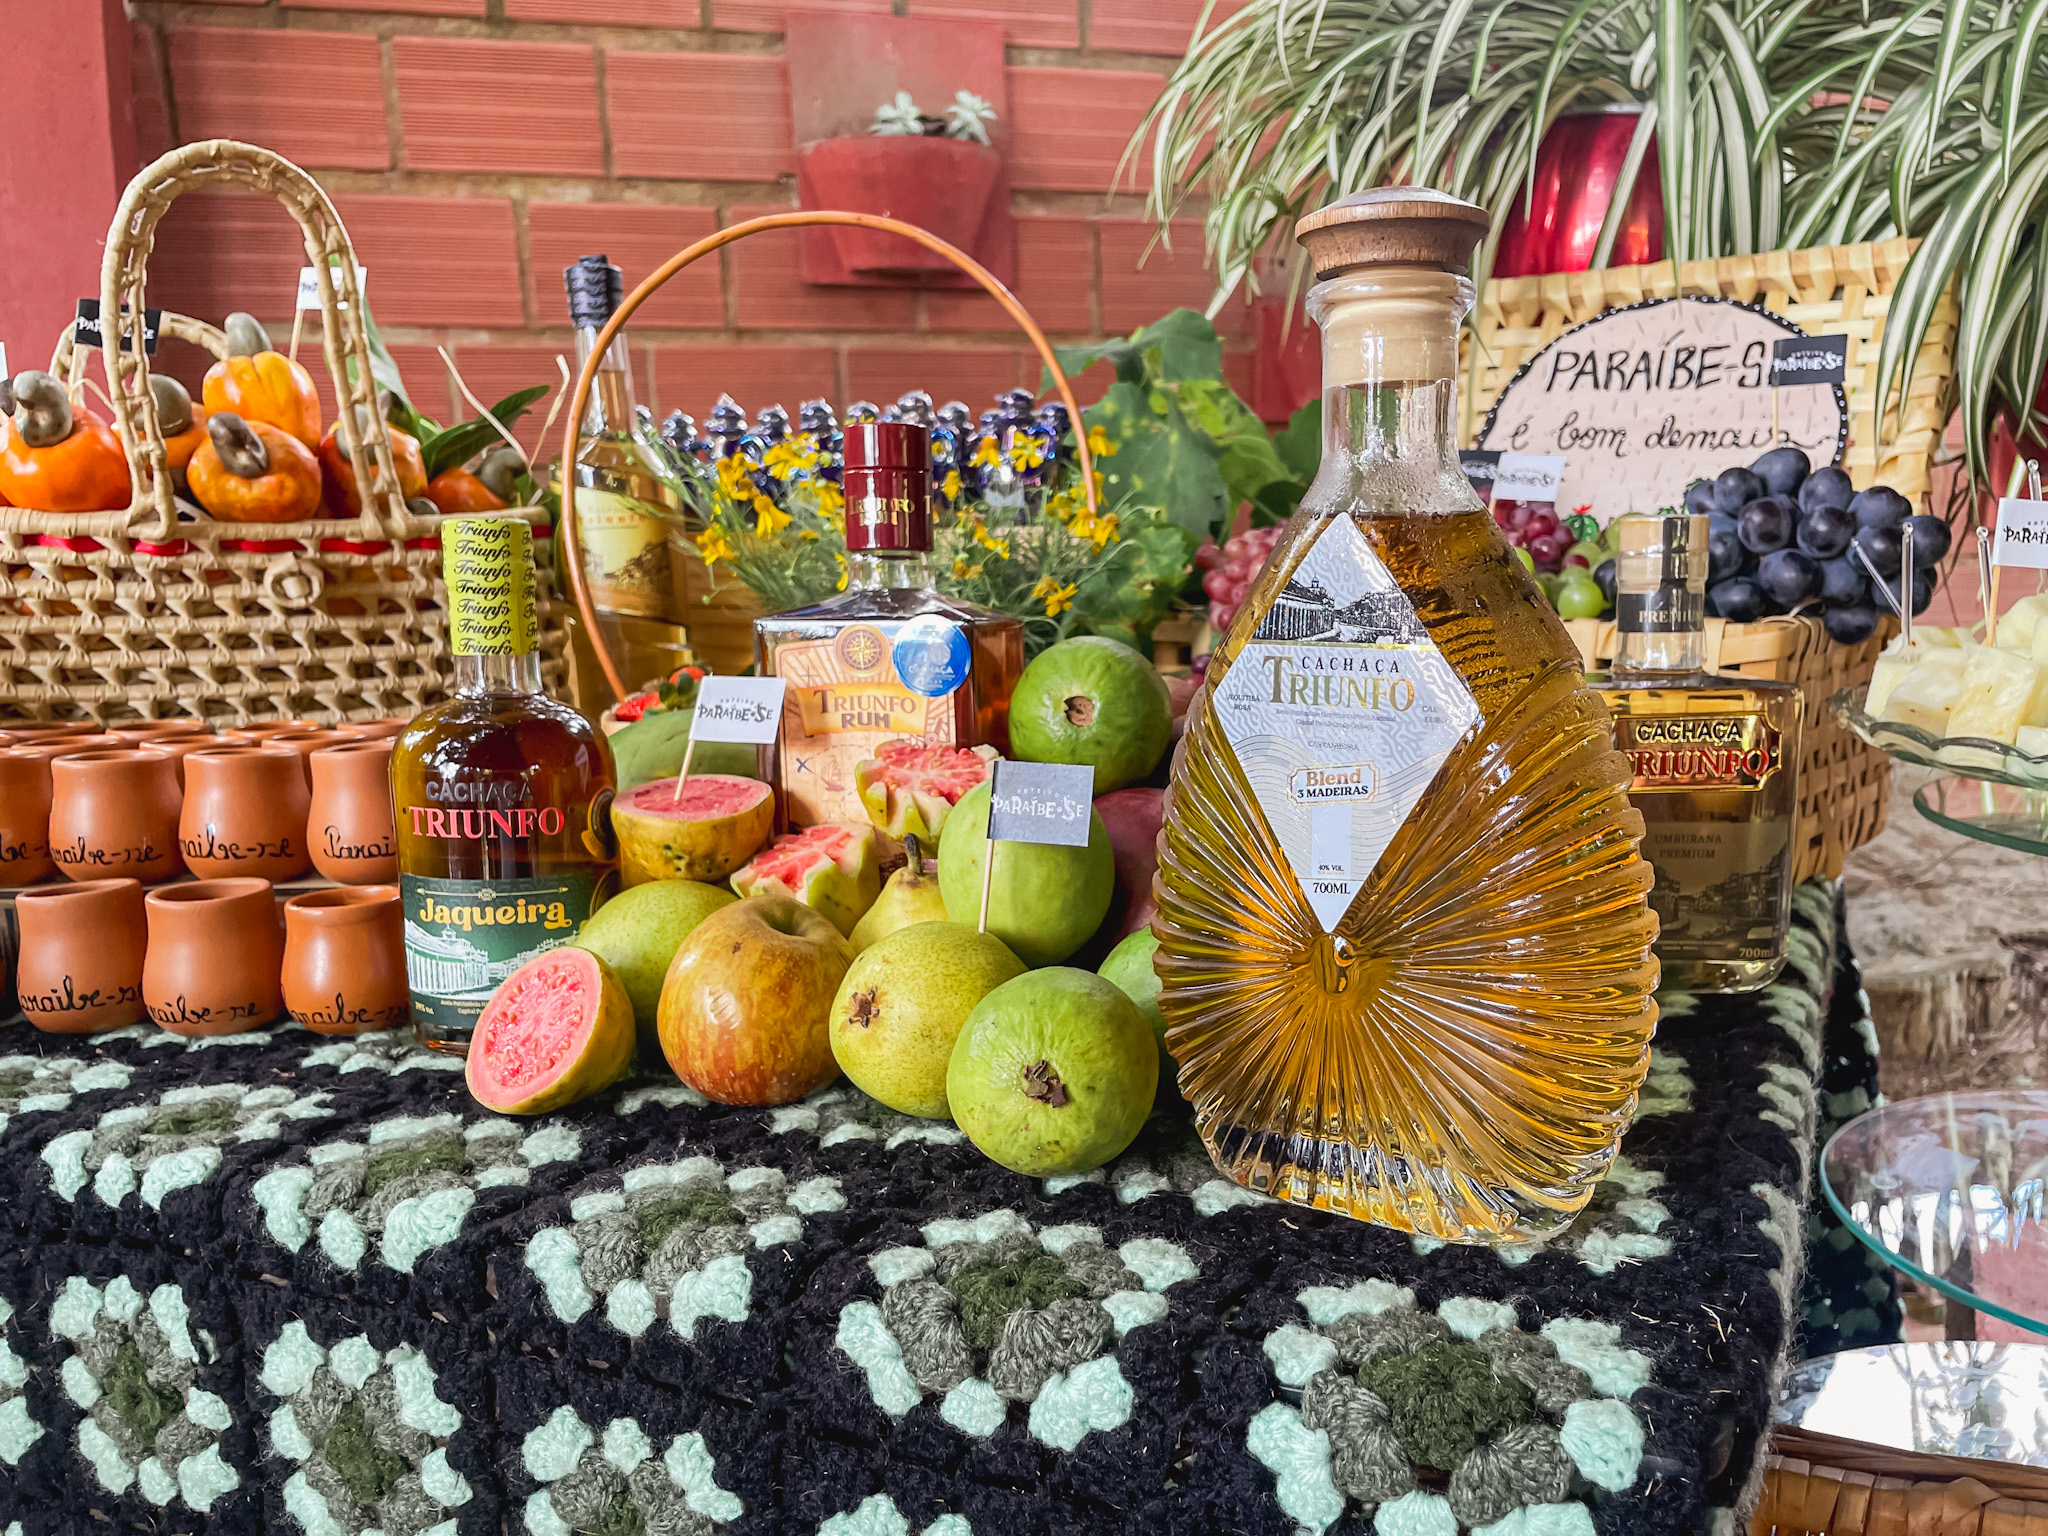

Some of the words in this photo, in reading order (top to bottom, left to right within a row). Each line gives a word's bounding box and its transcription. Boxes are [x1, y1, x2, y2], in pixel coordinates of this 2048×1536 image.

[1545, 331, 1776, 393] PARAÍBE-S
[1510, 416, 1531, 450] é
[1557, 411, 1628, 457] bom
[848, 496, 915, 515] TRNFO
[454, 520, 511, 543] Triunfo
[454, 540, 511, 562] Triunfo
[454, 560, 511, 582] Triunfo
[456, 579, 511, 601] Triunfo
[457, 599, 510, 620] Triunfo
[457, 618, 512, 640] Triunfo
[1302, 656, 1400, 676] CACHAÇA
[1262, 656, 1415, 712] TRIUNFO
[813, 689, 918, 714] TRIUNFO
[841, 712, 890, 729] RUM
[1636, 722, 1743, 747] CACHAÇA
[1306, 768, 1362, 787] Blend
[426, 781, 534, 806] CACHAÇA
[1297, 789, 1304, 799] 3
[1307, 786, 1369, 798] MADEIRAS
[409, 806, 565, 839] TRIUNFO
[324, 825, 397, 859] Parai
[1654, 834, 1722, 844] UMBURANA
[1659, 849, 1715, 859] PREMIUM
[1313, 882, 1351, 894] 700ML
[420, 898, 572, 931] Jaqueira
[1739, 947, 1774, 958] 700ml
